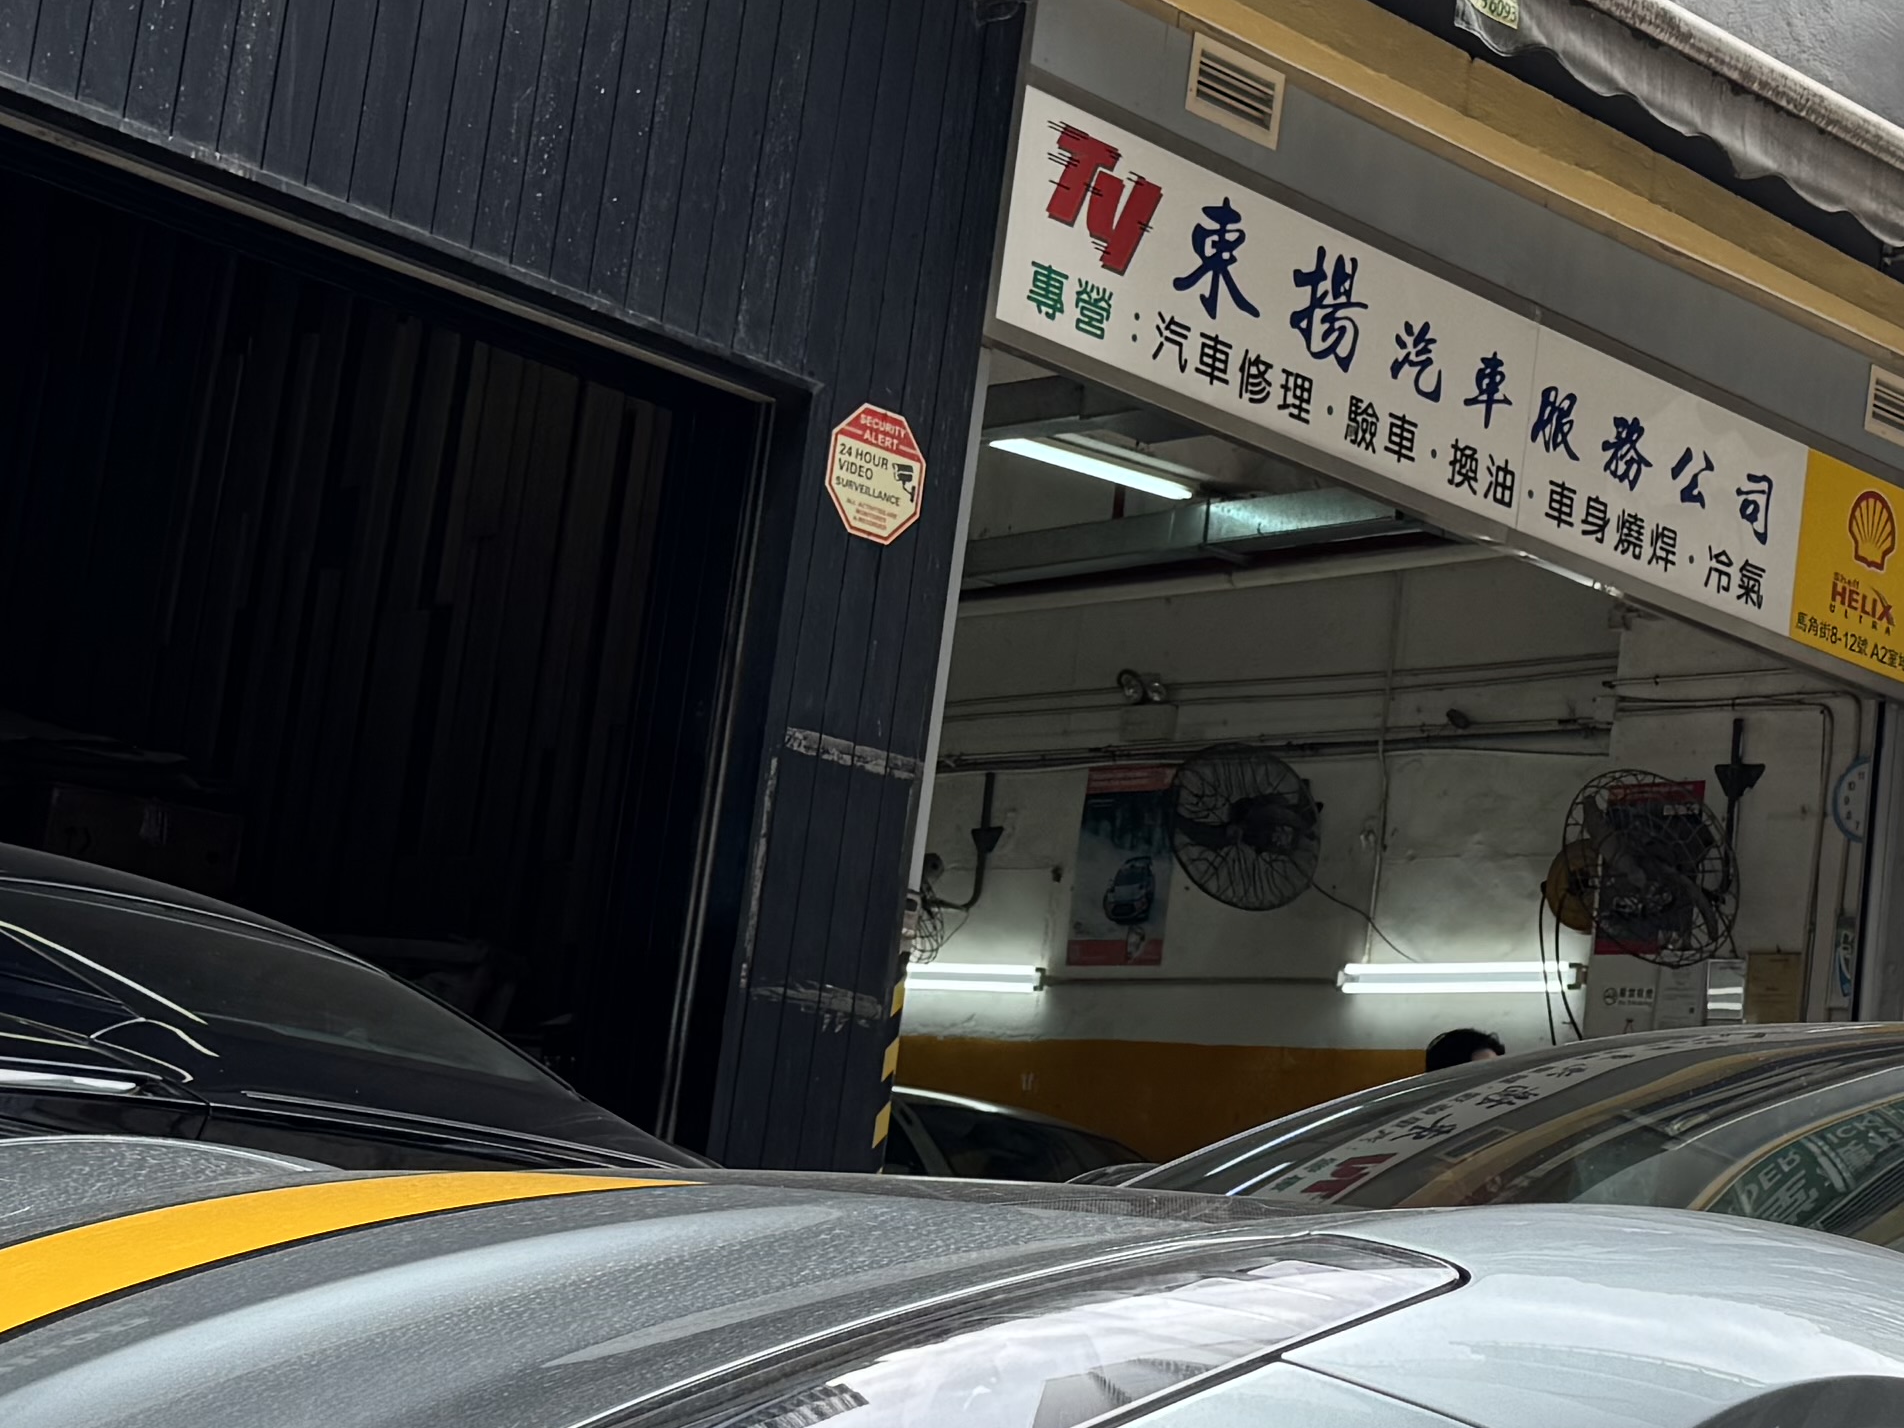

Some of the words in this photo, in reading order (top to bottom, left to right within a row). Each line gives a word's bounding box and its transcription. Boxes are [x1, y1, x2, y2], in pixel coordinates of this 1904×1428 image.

[1172, 196, 1775, 545] 東揚汽車服務公司
[860, 413, 907, 439] SECURITY
[863, 429, 900, 451] ALERT
[838, 458, 874, 481] VIDEO
[839, 443, 853, 457] 24
[855, 447, 889, 471] HOUR
[835, 475, 902, 508] SURVEILLANCE
[1830, 580, 1896, 627] HELIX
